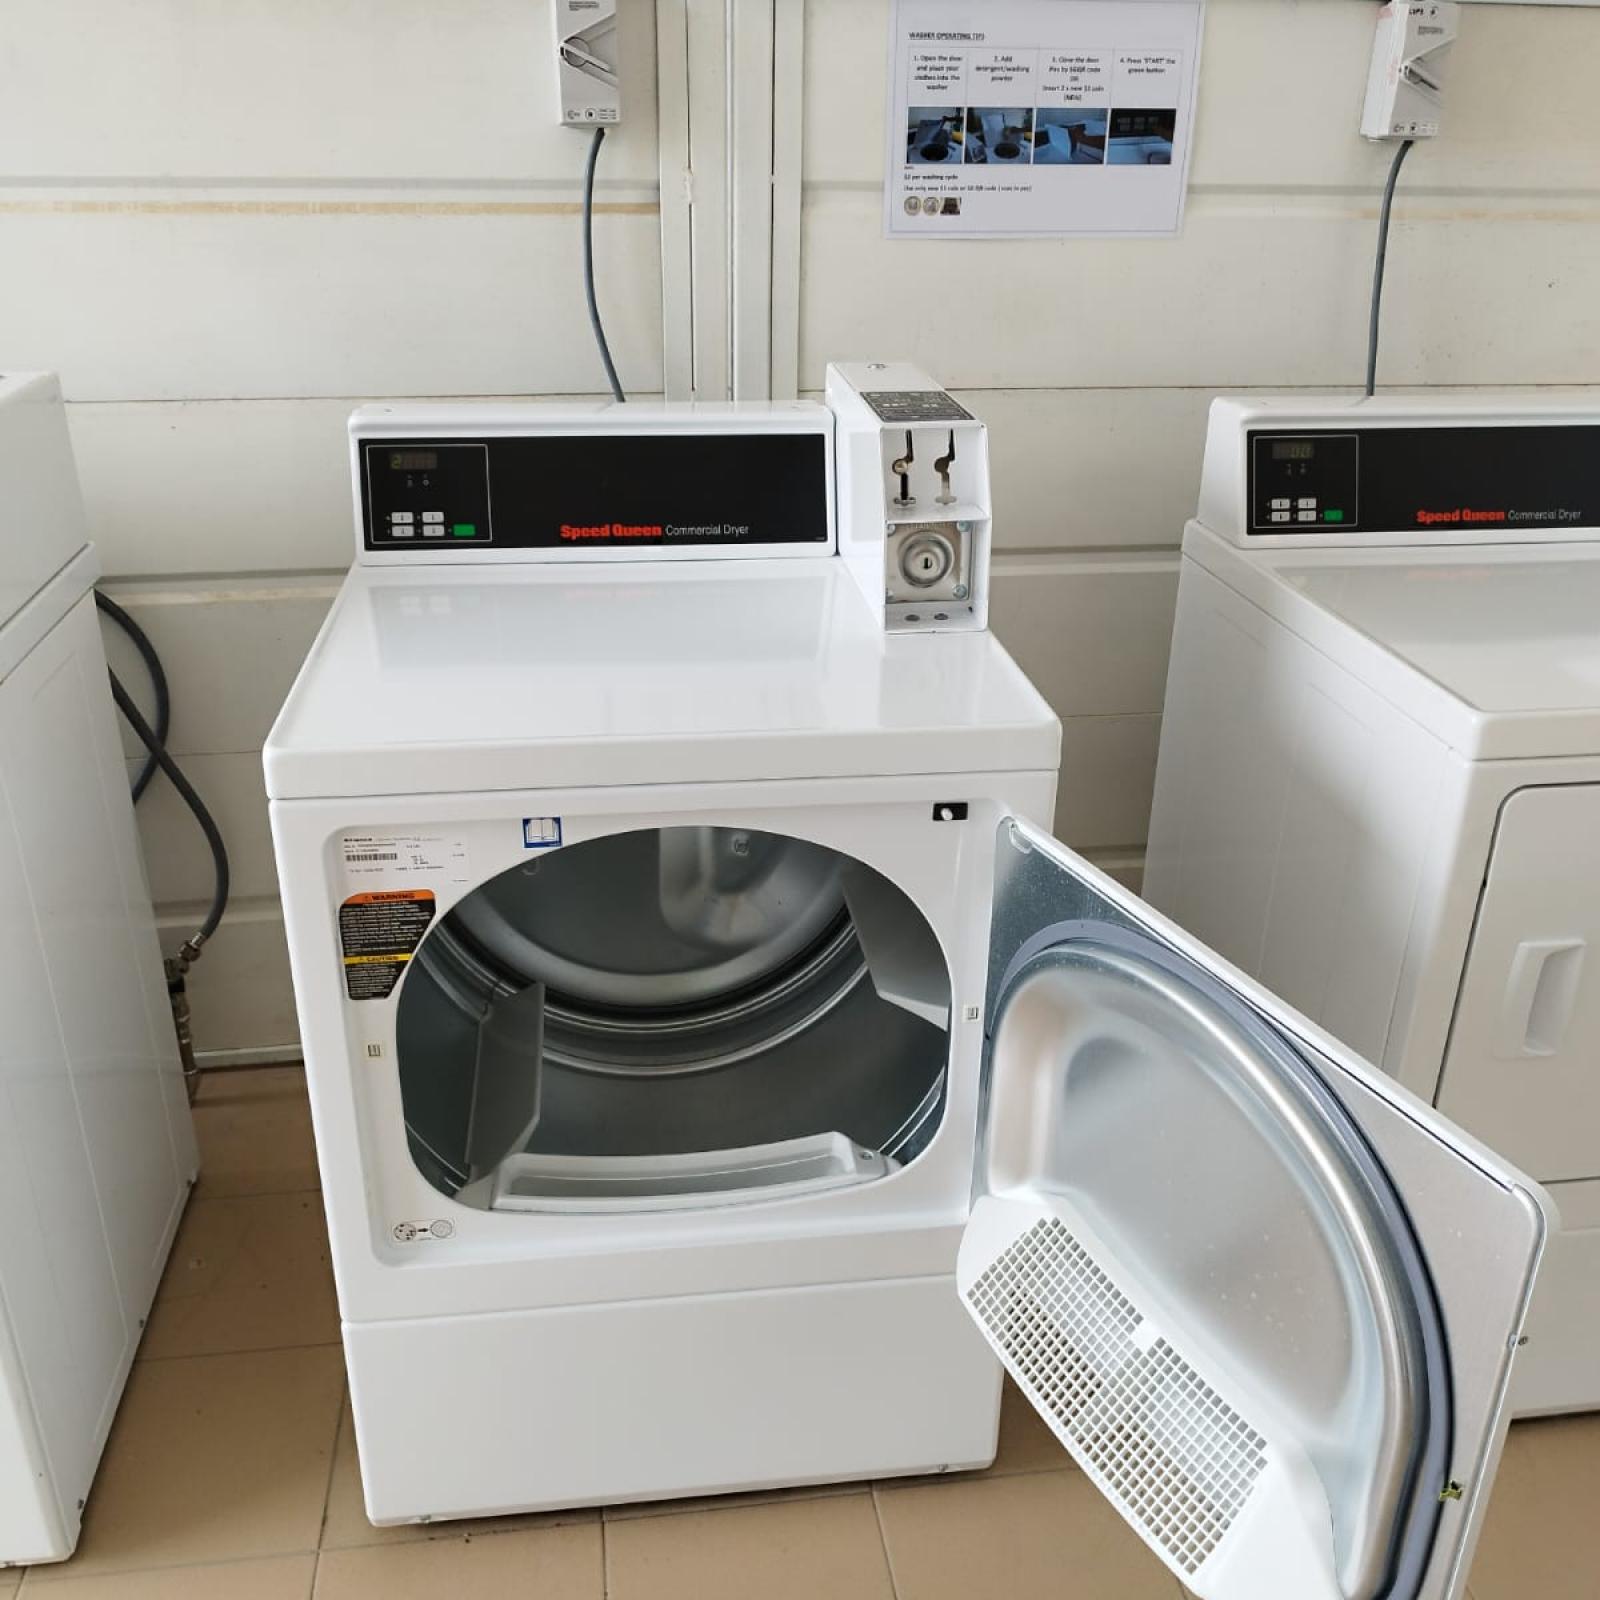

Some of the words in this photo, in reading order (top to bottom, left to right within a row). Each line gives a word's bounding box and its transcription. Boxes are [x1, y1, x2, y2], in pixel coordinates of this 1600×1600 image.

[908, 32, 935, 40] WASHER
[936, 32, 971, 40] OPERATING
[920, 55, 936, 63] Open
[1061, 66, 1068, 74] by
[1416, 509, 1460, 525] Speed
[1462, 508, 1505, 521] Queen
[1507, 508, 1556, 521] Commercial
[1558, 508, 1582, 522] Dryer
[560, 524, 610, 540] Speed
[612, 523, 662, 537] Queen
[665, 523, 721, 537] Commercial
[723, 524, 749, 538] Dryer
[371, 892, 416, 901] WARNING
